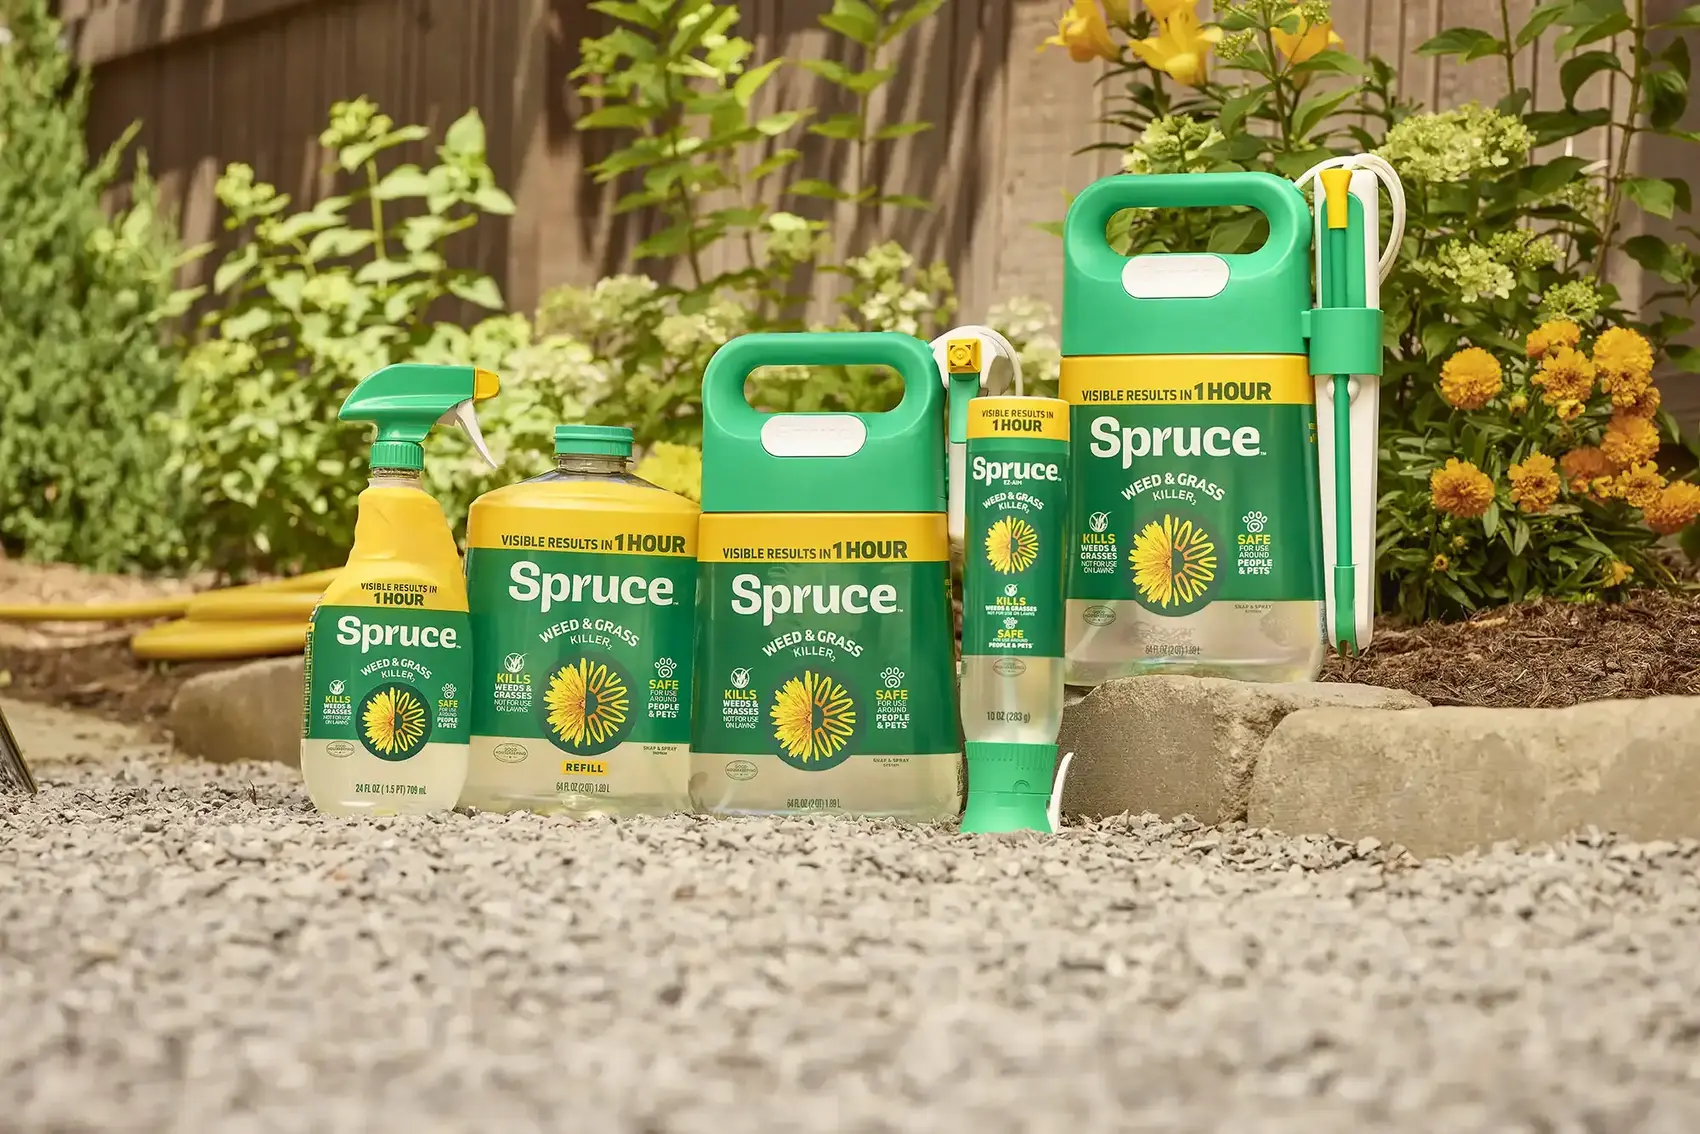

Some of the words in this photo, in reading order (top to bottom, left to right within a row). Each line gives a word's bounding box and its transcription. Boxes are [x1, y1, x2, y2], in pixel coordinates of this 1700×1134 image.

[1082, 390, 1124, 401] VISIBLE
[1127, 390, 1177, 401] RESULTS
[1180, 390, 1192, 400] IN
[1194, 382, 1203, 400] 1
[1208, 382, 1272, 400] HOUR
[1011, 410, 1045, 418] RESULTS
[993, 419, 998, 431] 1
[1002, 419, 1042, 432] HOUR
[1121, 474, 1162, 500] WEED
[1164, 472, 1175, 484] &
[1177, 472, 1226, 501] GRASS
[982, 492, 1006, 509] WEED
[1008, 492, 1014, 500] &
[1016, 492, 1044, 510] GRASS
[501, 535, 545, 547] VISIBLE
[548, 537, 598, 550] RESULTS
[601, 539, 612, 550] IN
[615, 534, 624, 551] 1
[627, 534, 686, 553] HOUR
[1082, 534, 1115, 544] KILLS
[1238, 534, 1271, 544] SAFE
[723, 548, 764, 559] VISIBLE
[767, 548, 816, 559] RESULTS
[819, 548, 831, 559] IN
[832, 541, 841, 559] 1
[846, 541, 908, 559] HOUR
[1080, 552, 1118, 560] GRASSES
[1081, 560, 1093, 568] NOT
[1093, 560, 1104, 568] FOR
[1238, 559, 1272, 567] PEOPLE
[361, 582, 391, 591] VISIBLE
[394, 584, 427, 593] RESULTS
[429, 585, 437, 593] IN
[374, 592, 380, 604] 1
[383, 593, 424, 606] HOUR
[996, 597, 1026, 606] KILLS
[538, 619, 579, 643] WEED
[582, 618, 592, 630] &
[595, 619, 640, 647] GRASS
[997, 630, 1024, 638] SAFE
[762, 631, 802, 657] WEED
[805, 629, 815, 642] &
[818, 630, 864, 658] GRASS
[360, 658, 390, 676] WEED
[392, 657, 399, 667] &
[401, 658, 432, 680] GRASS
[496, 673, 531, 684] KILLS
[495, 684, 524, 692] WEEDS
[649, 680, 679, 690] SAFE
[494, 691, 532, 700] GRASSES
[724, 690, 757, 699] KILLS
[876, 690, 908, 700] SAFE
[438, 700, 458, 708] SAFE
[648, 703, 679, 711] PEOPLE
[723, 700, 750, 708] WEEDS
[752, 700, 758, 708] &
[648, 710, 654, 718] &
[722, 707, 759, 716] GRASSES
[987, 712, 995, 720] 10
[996, 712, 1004, 720] OZ
[1006, 712, 1022, 723] (283
[1024, 713, 1030, 723] g)
[877, 721, 883, 729] &
[566, 763, 603, 773] REFILL
[356, 784, 363, 792] 24
[364, 784, 371, 792] FL
[372, 784, 380, 793] OZ
[396, 785, 405, 795] PT)
[407, 785, 417, 794] 709
[419, 786, 426, 794] mL
